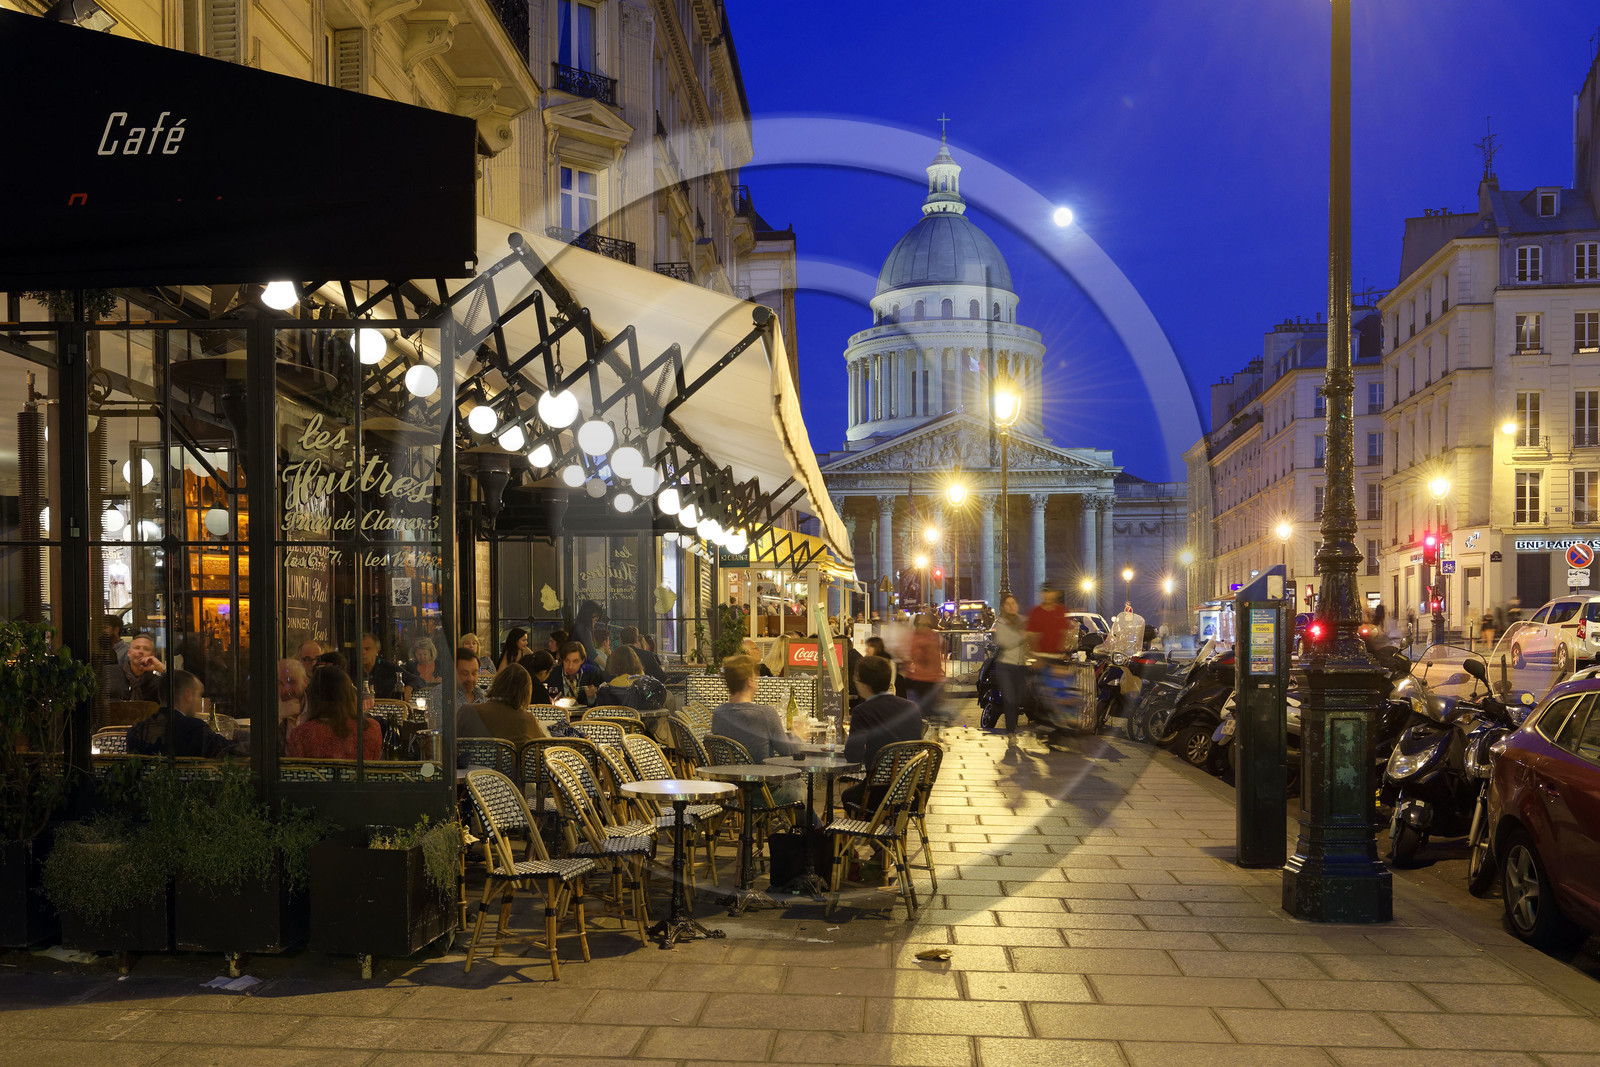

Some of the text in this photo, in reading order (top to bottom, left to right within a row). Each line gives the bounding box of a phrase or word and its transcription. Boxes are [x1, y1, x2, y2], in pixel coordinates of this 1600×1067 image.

[97, 111, 187, 156] Café
[298, 412, 349, 450] les
[333, 510, 355, 531] de
[1515, 540, 1544, 550] BNP
[365, 551, 388, 567] les
[287, 574, 310, 600] LUNCH
[287, 617, 310, 630] DINNER
[966, 644, 979, 660] P
